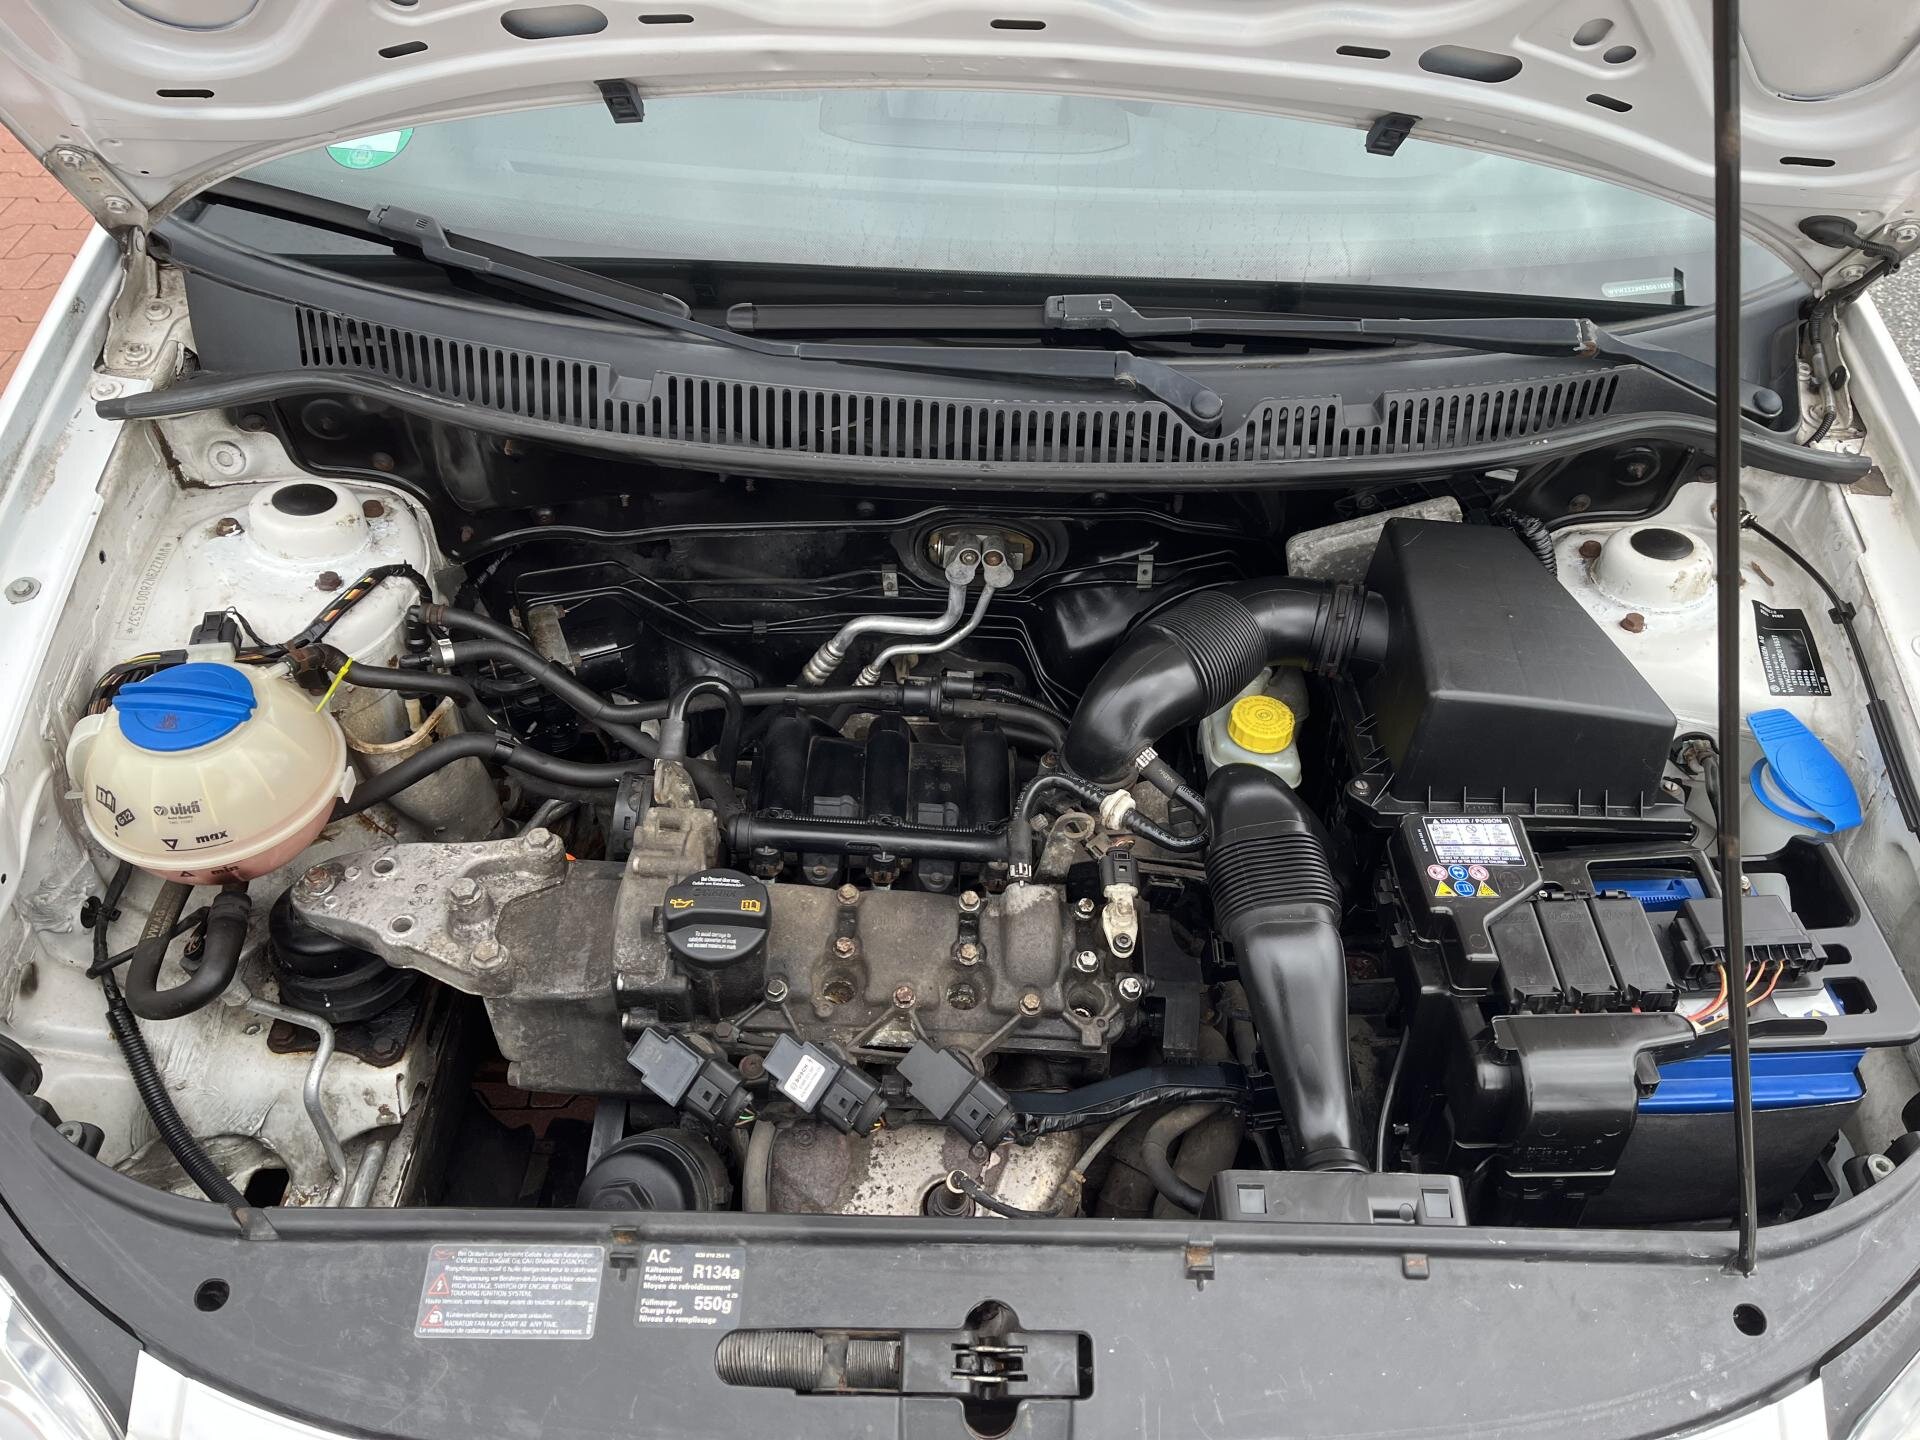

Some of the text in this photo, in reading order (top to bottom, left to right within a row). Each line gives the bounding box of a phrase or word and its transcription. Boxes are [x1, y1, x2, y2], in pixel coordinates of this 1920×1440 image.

[1761, 645, 1776, 683] VOLKSWAGEN
[117, 811, 133, 825] G12
[195, 830, 228, 844] max
[211, 866, 240, 876] min
[646, 1248, 671, 1263] AC
[693, 1264, 740, 1280] R134a
[694, 1296, 732, 1314] 550g
